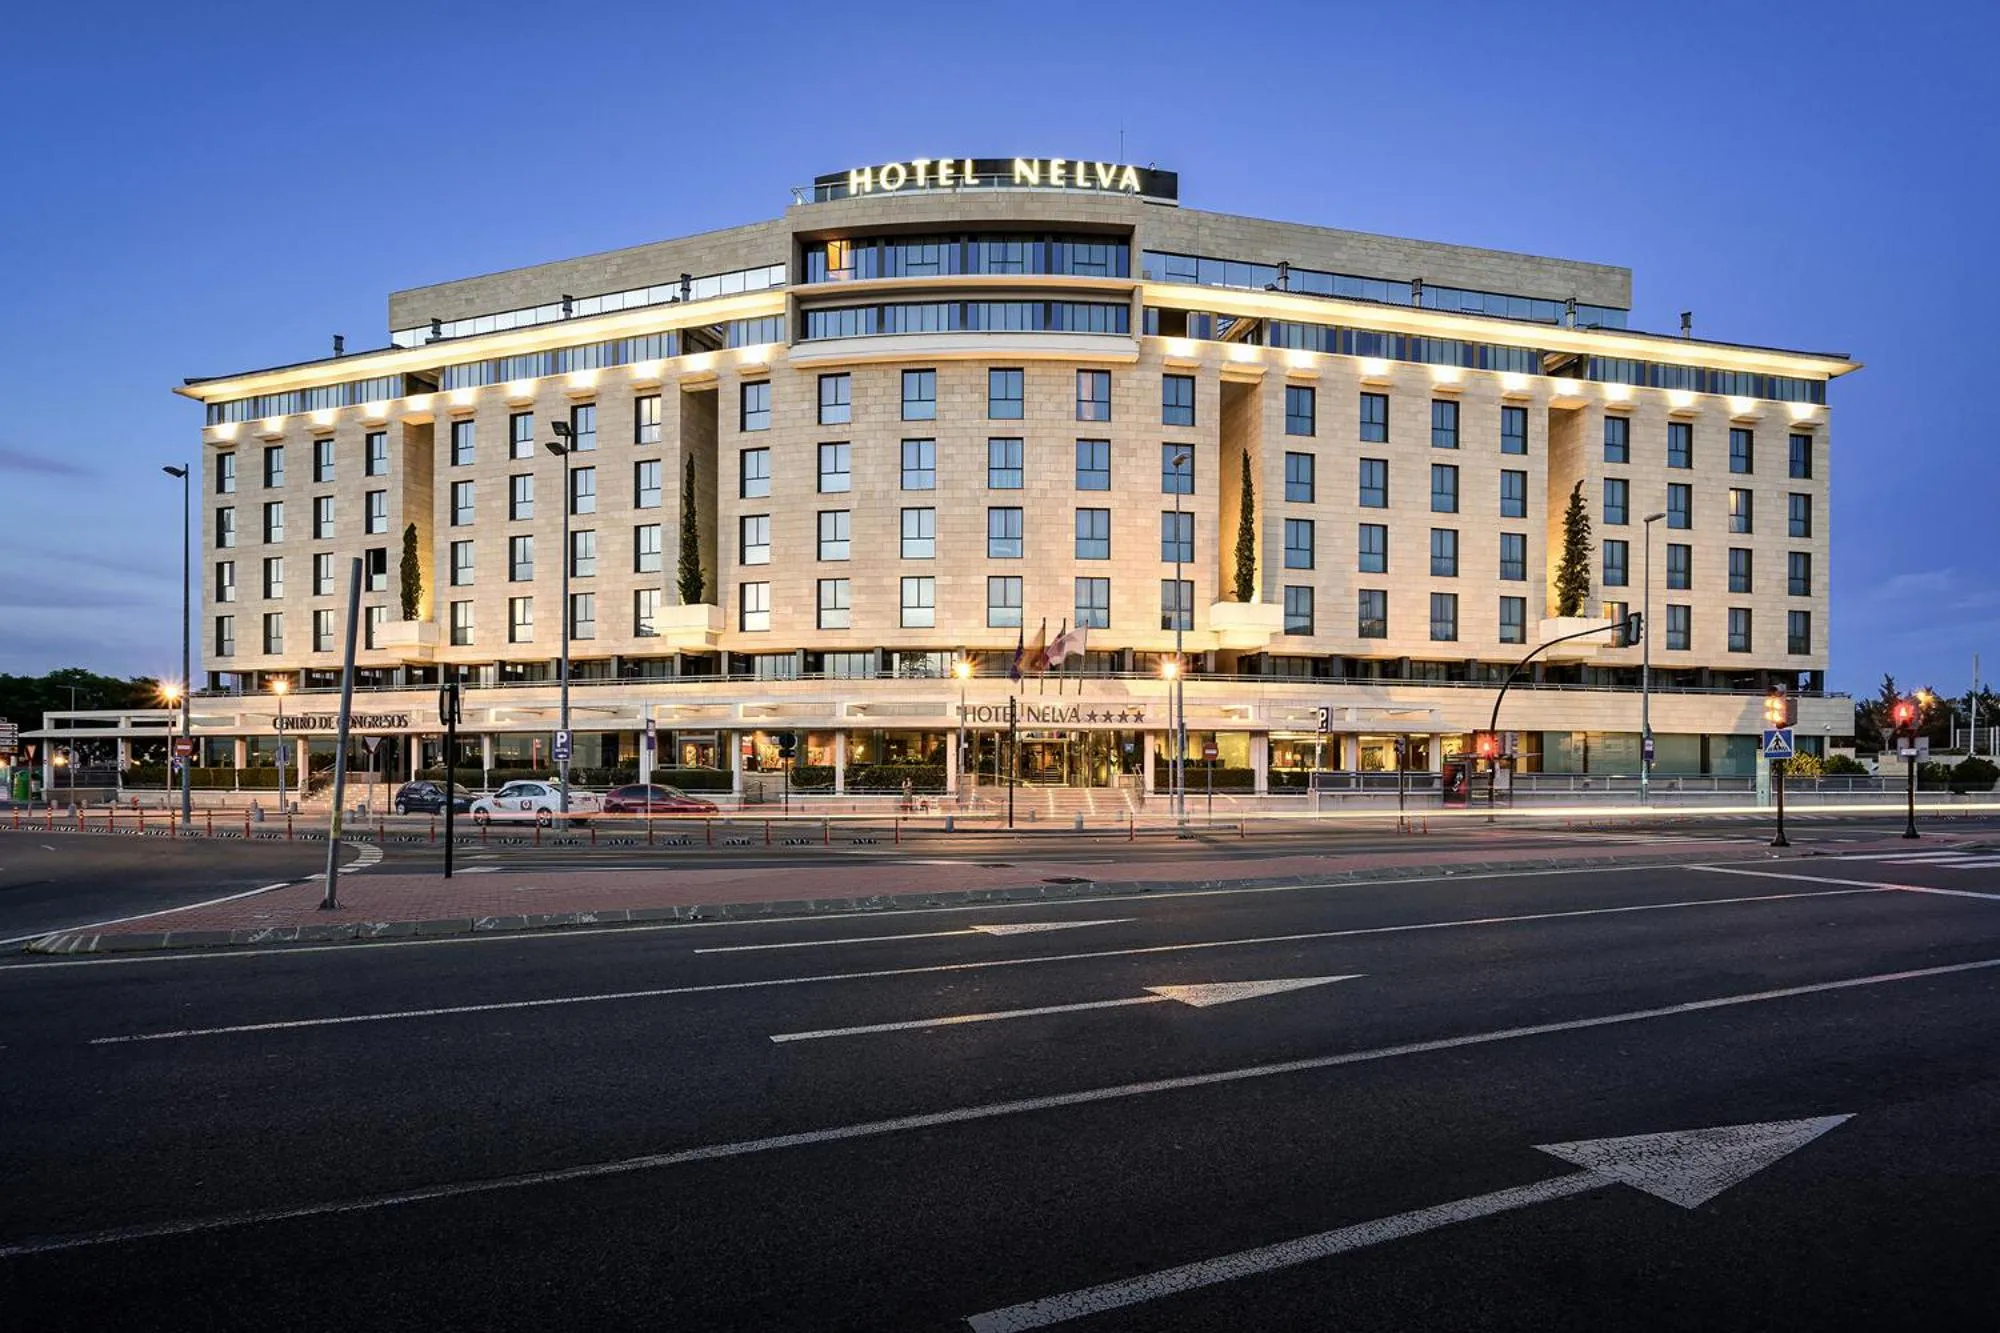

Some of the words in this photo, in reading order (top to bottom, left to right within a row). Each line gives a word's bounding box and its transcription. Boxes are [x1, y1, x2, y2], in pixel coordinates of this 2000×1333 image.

[849, 158, 980, 195] HOTEL
[1014, 157, 1142, 192] NELVA
[272, 715, 317, 730] CENTRO
[319, 715, 335, 730] DE
[1027, 705, 1080, 723] NELVA
[1319, 709, 1327, 728] P
[557, 731, 568, 748] P
